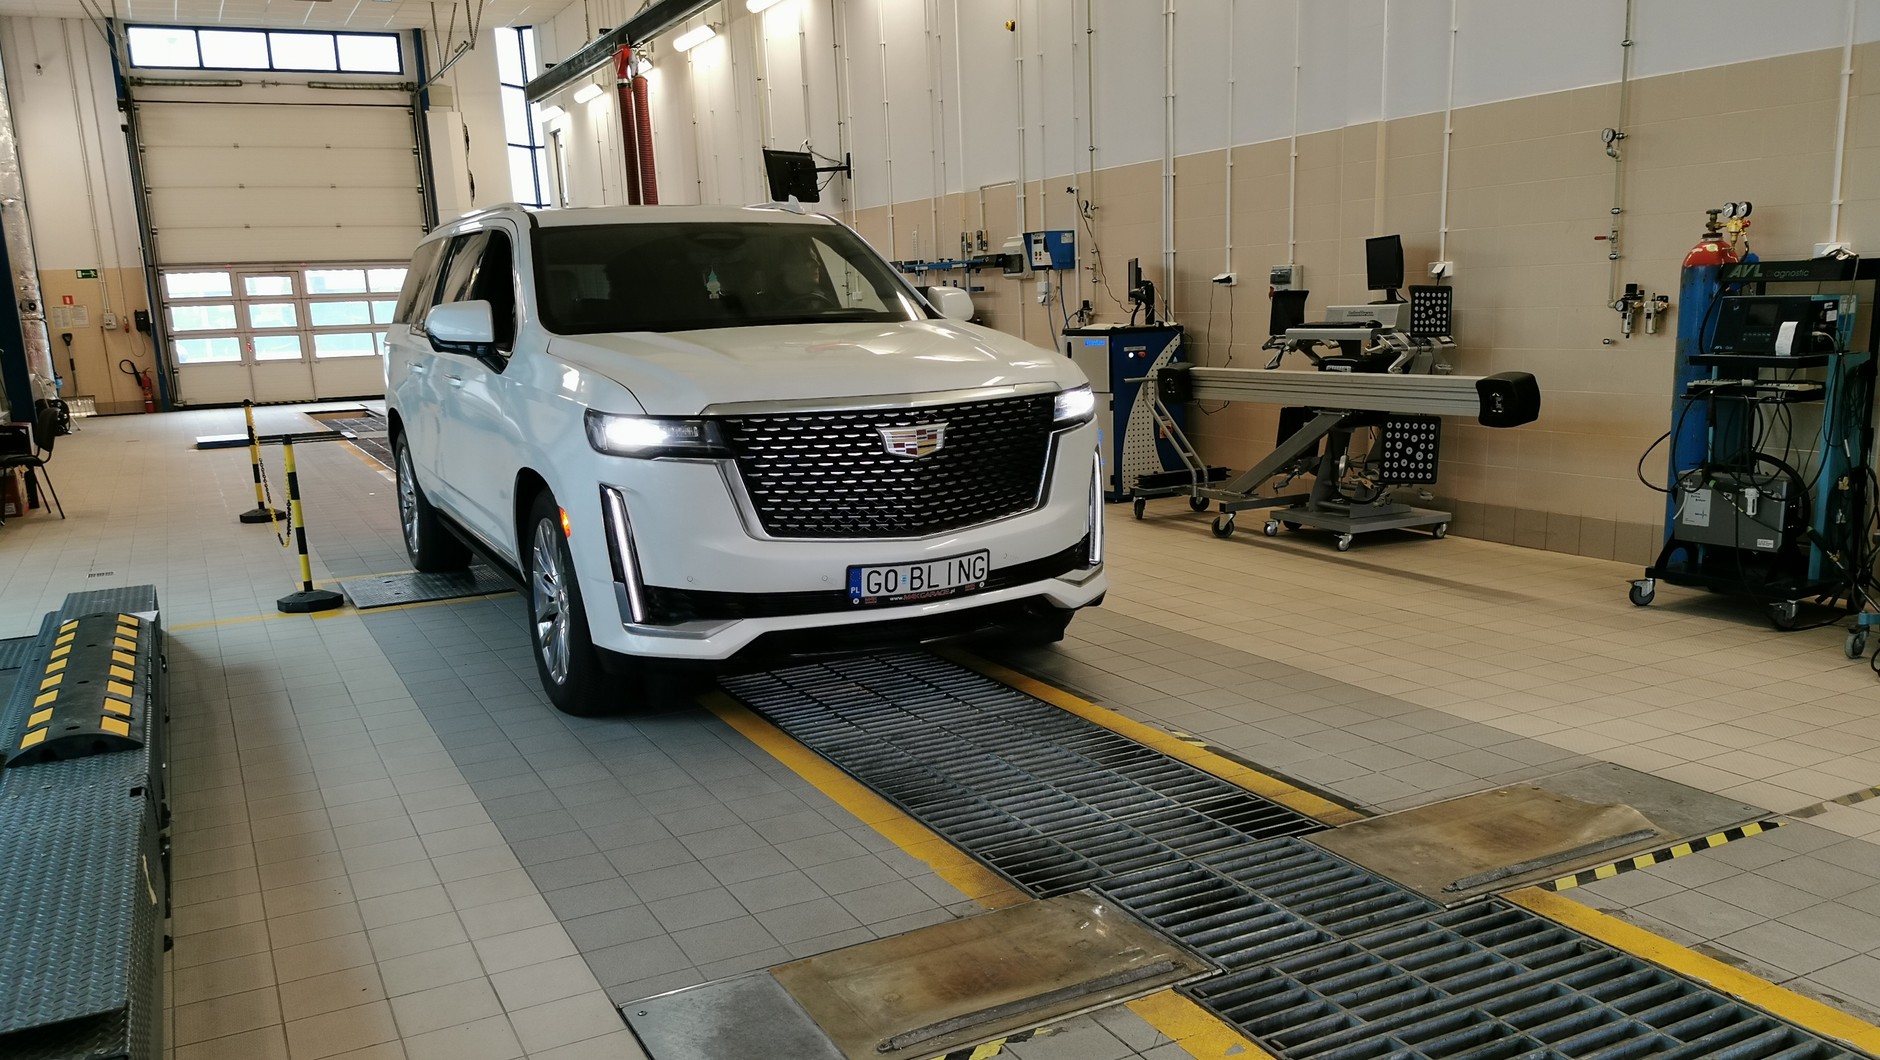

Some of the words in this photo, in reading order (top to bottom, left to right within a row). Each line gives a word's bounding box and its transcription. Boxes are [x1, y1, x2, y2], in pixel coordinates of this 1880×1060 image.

[1729, 264, 1763, 278] AVL
[910, 556, 985, 591] BLING
[850, 586, 860, 594] PL
